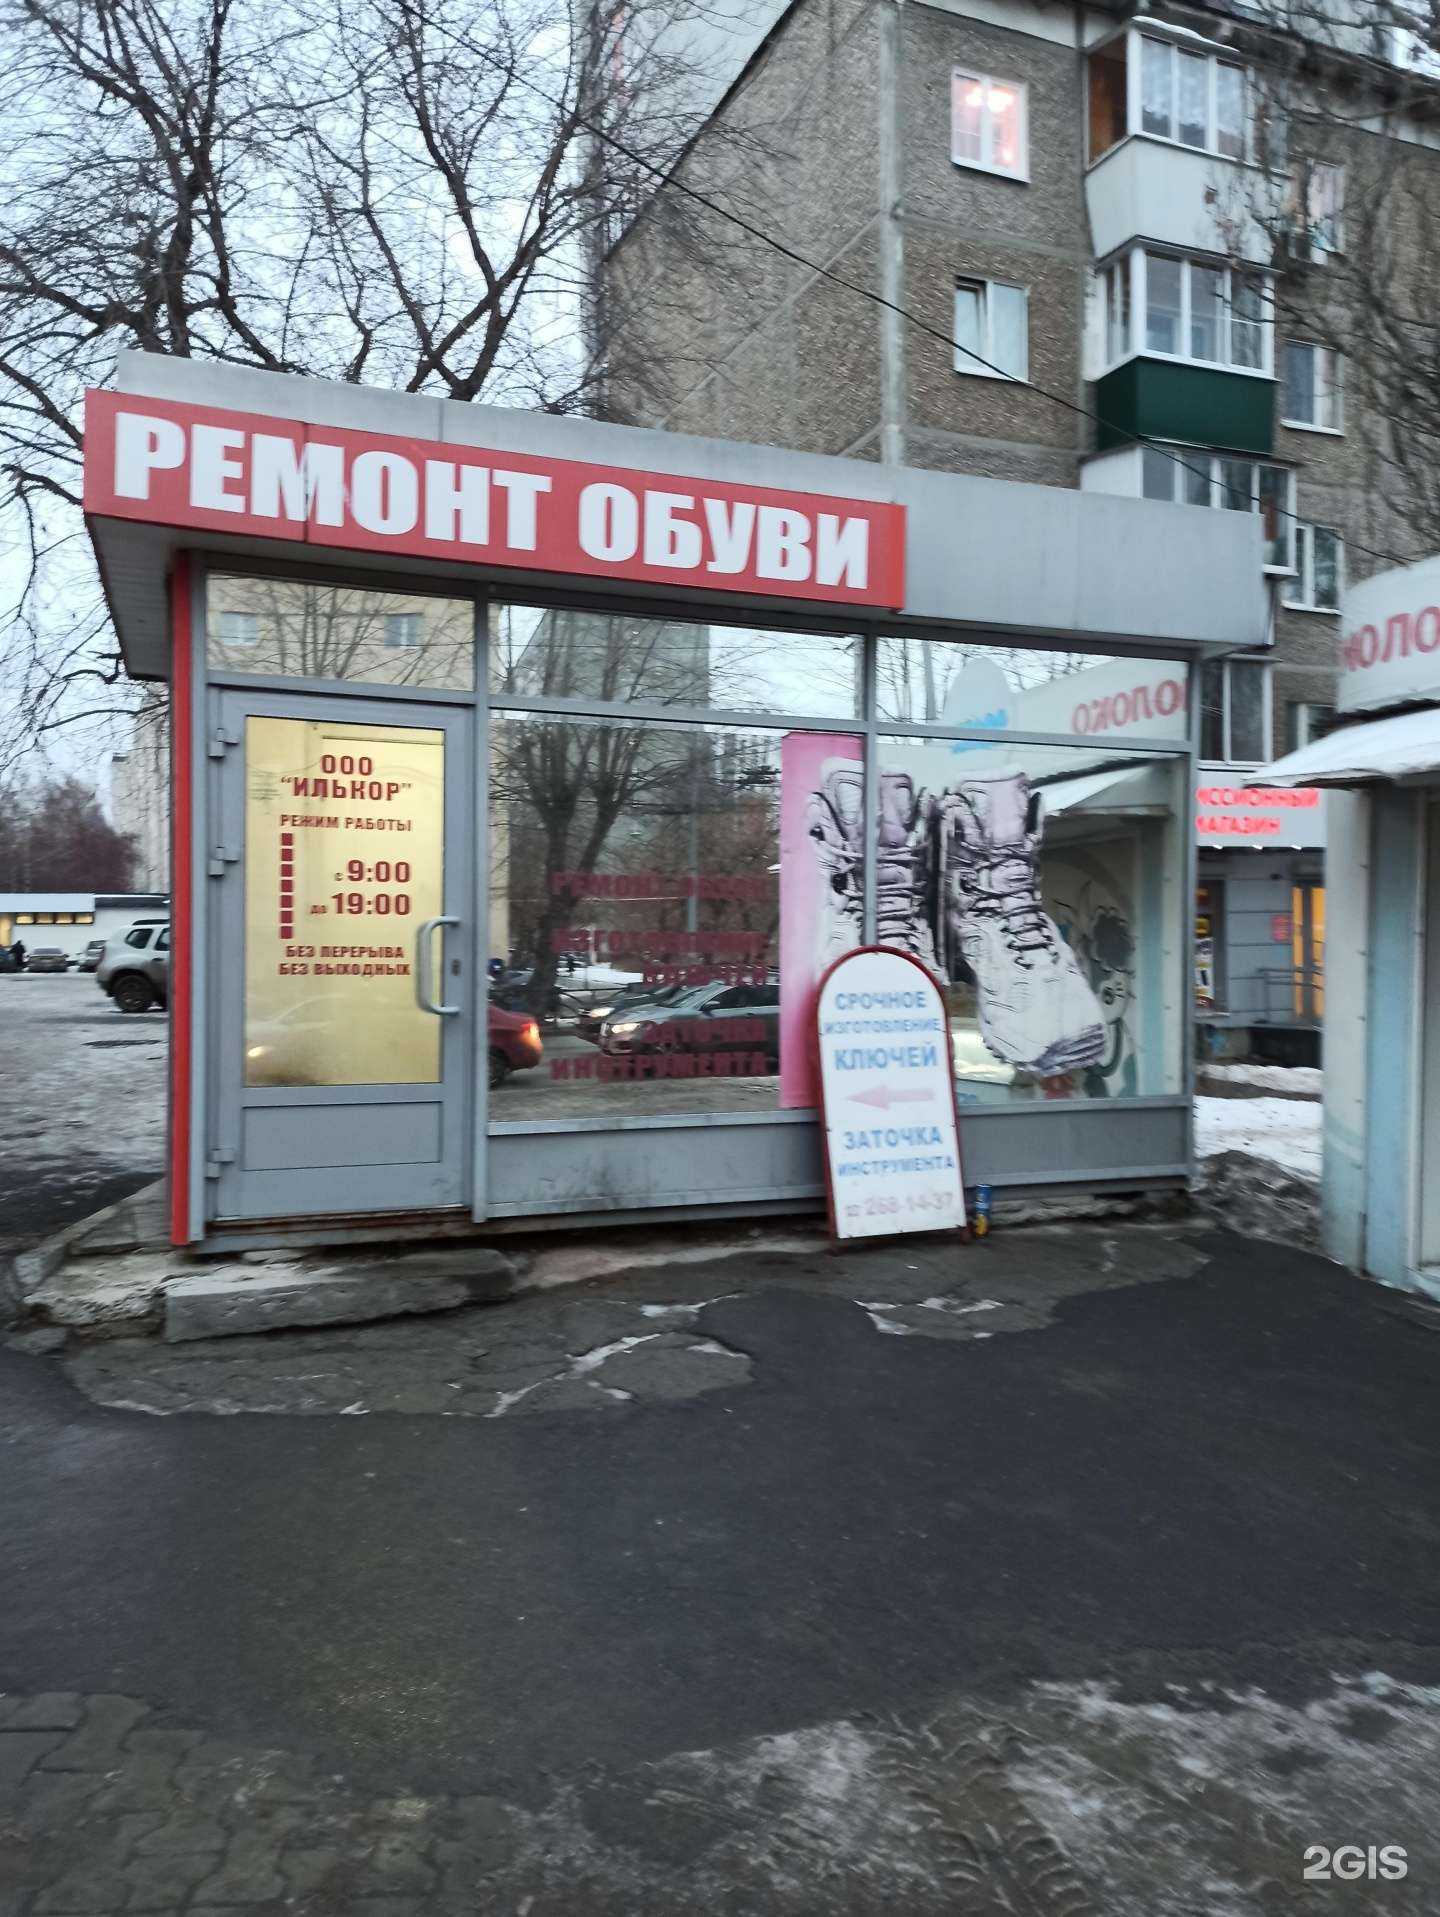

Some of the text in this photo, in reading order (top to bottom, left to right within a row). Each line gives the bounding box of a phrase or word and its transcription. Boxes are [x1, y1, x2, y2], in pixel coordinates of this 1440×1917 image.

[114, 411, 869, 589] РЕМОНТ ОБУВИ
[321, 754, 373, 776] ООО
[280, 814, 412, 832] РЕЖИМ РАБОТЫ
[347, 859, 411, 883] 9:00
[332, 892, 411, 916] 19:00
[286, 945, 404, 958] БЕЗ ПЕРЕРЫВА
[278, 963, 411, 977] БЕЗ ВЫХОДНЫХ
[835, 991, 927, 1011] СРОЧНОЕ
[824, 1018, 940, 1035] ИЗГОТОВЛЕНИЕ
[835, 1041, 938, 1070] КЛЮЧЕЙ
[843, 1126, 944, 1150] ЗАТОЧКА
[838, 1155, 955, 1177] ИНСТРУМЕНТА
